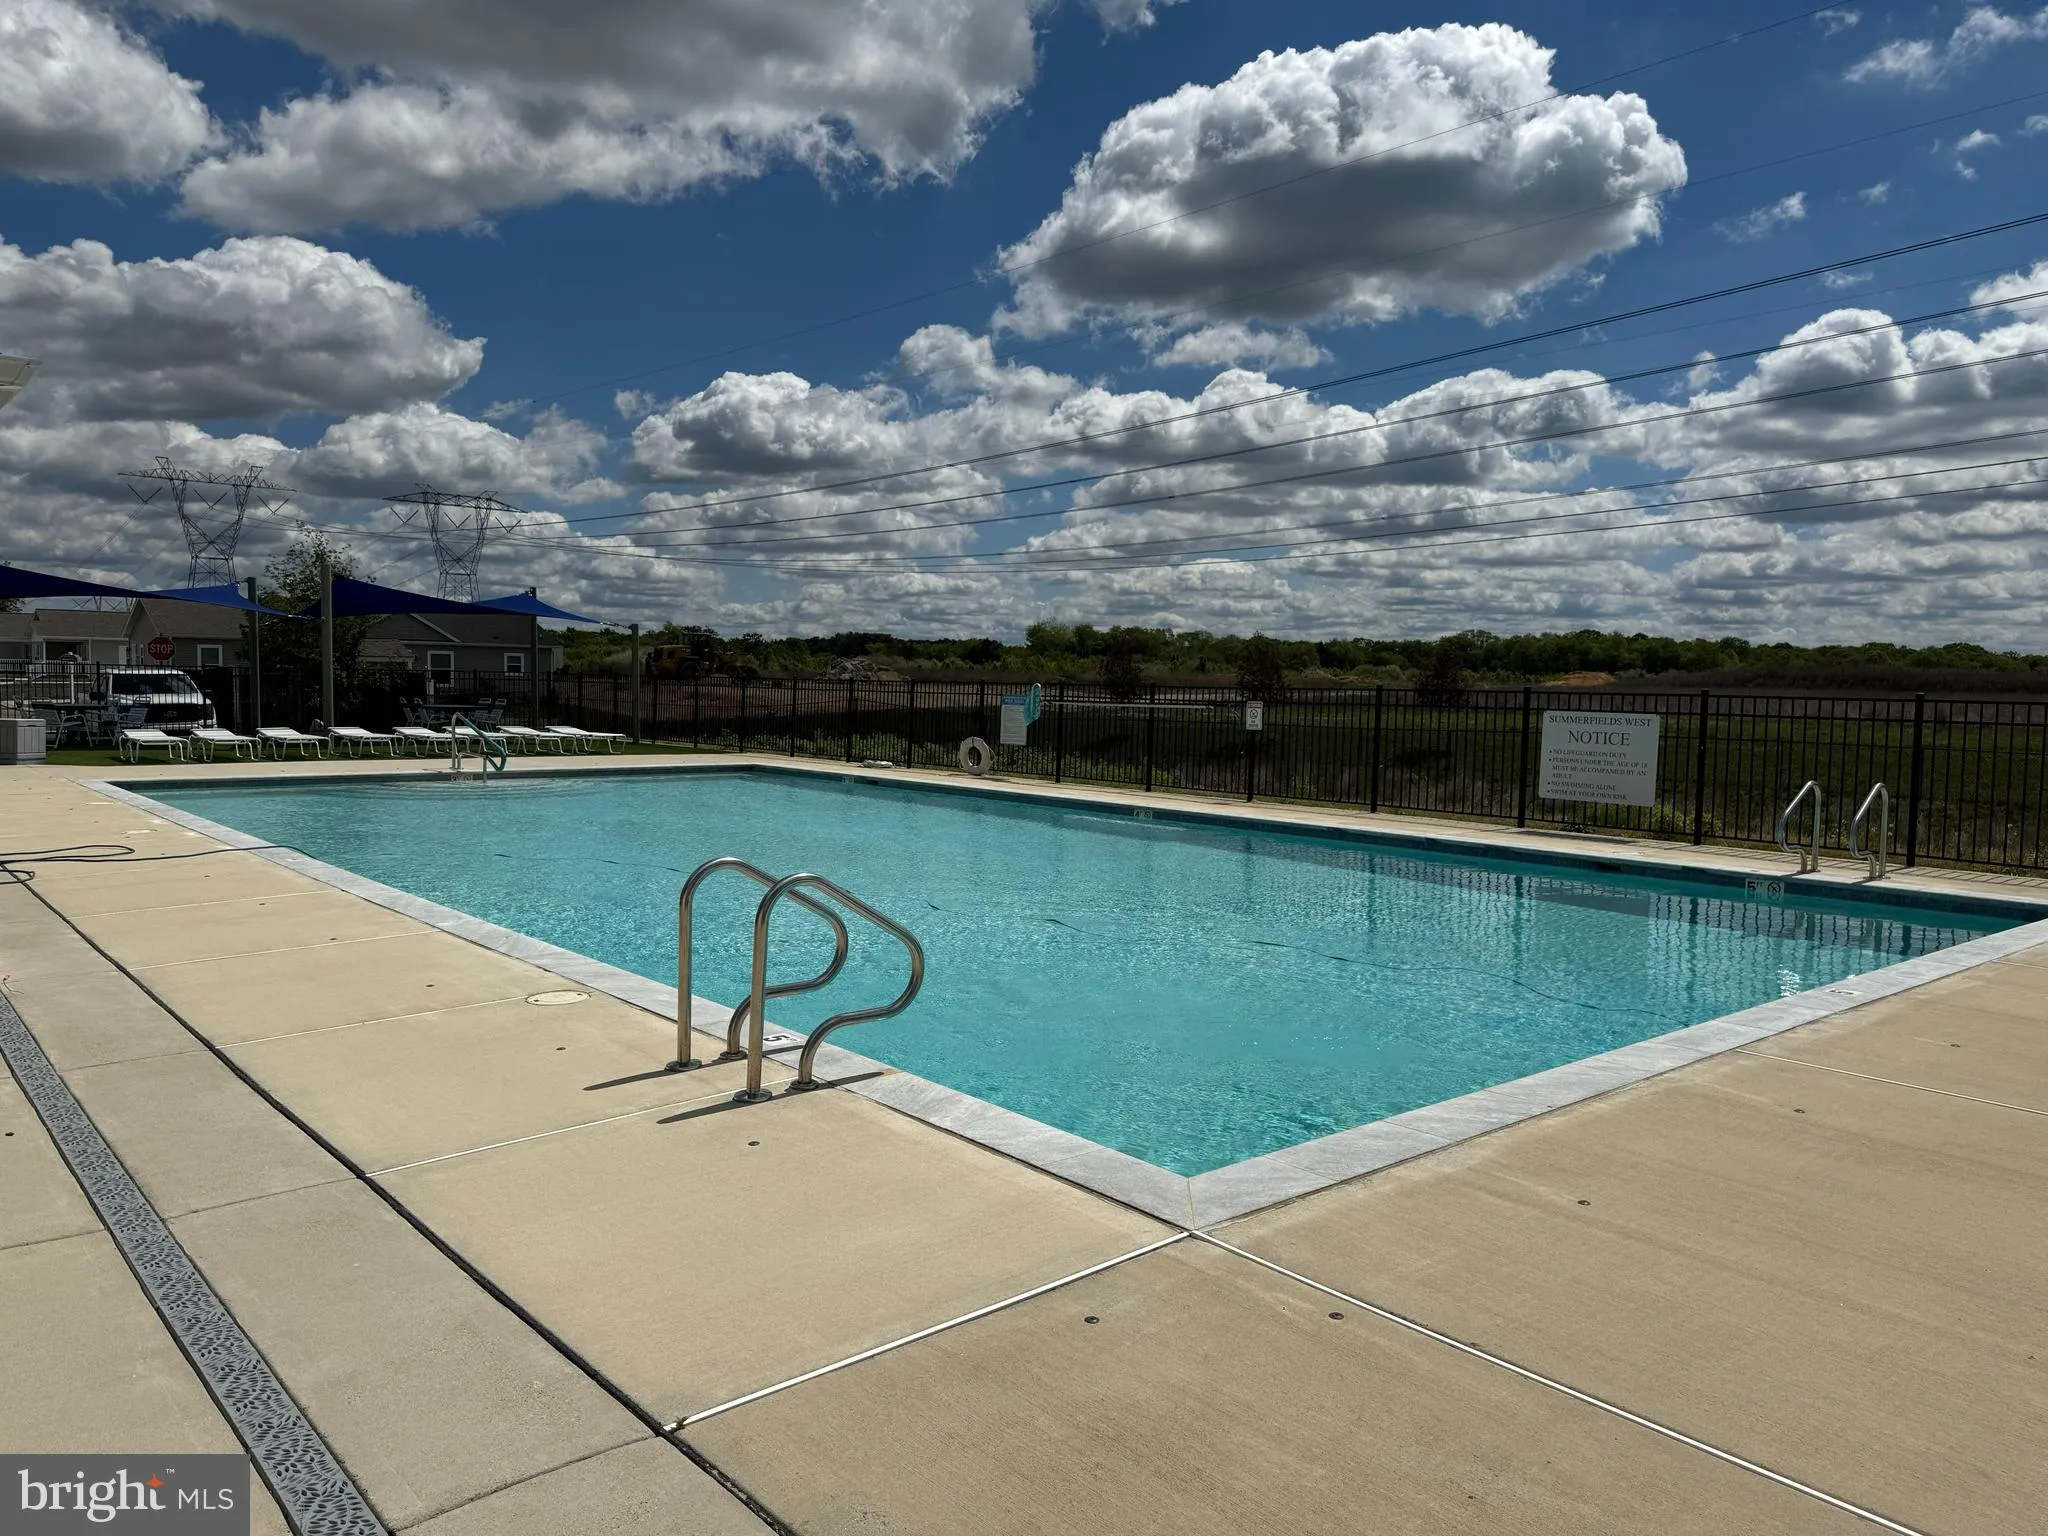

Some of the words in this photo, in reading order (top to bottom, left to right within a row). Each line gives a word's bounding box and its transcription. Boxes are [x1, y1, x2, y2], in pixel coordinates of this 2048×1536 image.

[149, 643, 174, 654] STOP
[1549, 715, 1623, 727] SUMMERFIELDS
[1624, 717, 1652, 728] WEST
[1568, 730, 1631, 746] NOTICE
[1563, 749, 1598, 757] LIFEGUARD
[1552, 757, 1580, 765] PERSONS
[1580, 758, 1602, 766] UNDER
[1603, 759, 1616, 767] THE
[1579, 766, 1625, 775] ACCOMPANIED
[1561, 781, 1595, 789] SWIMMING
[1612, 793, 1628, 801] RISK
[763, 1034, 791, 1042] 5
